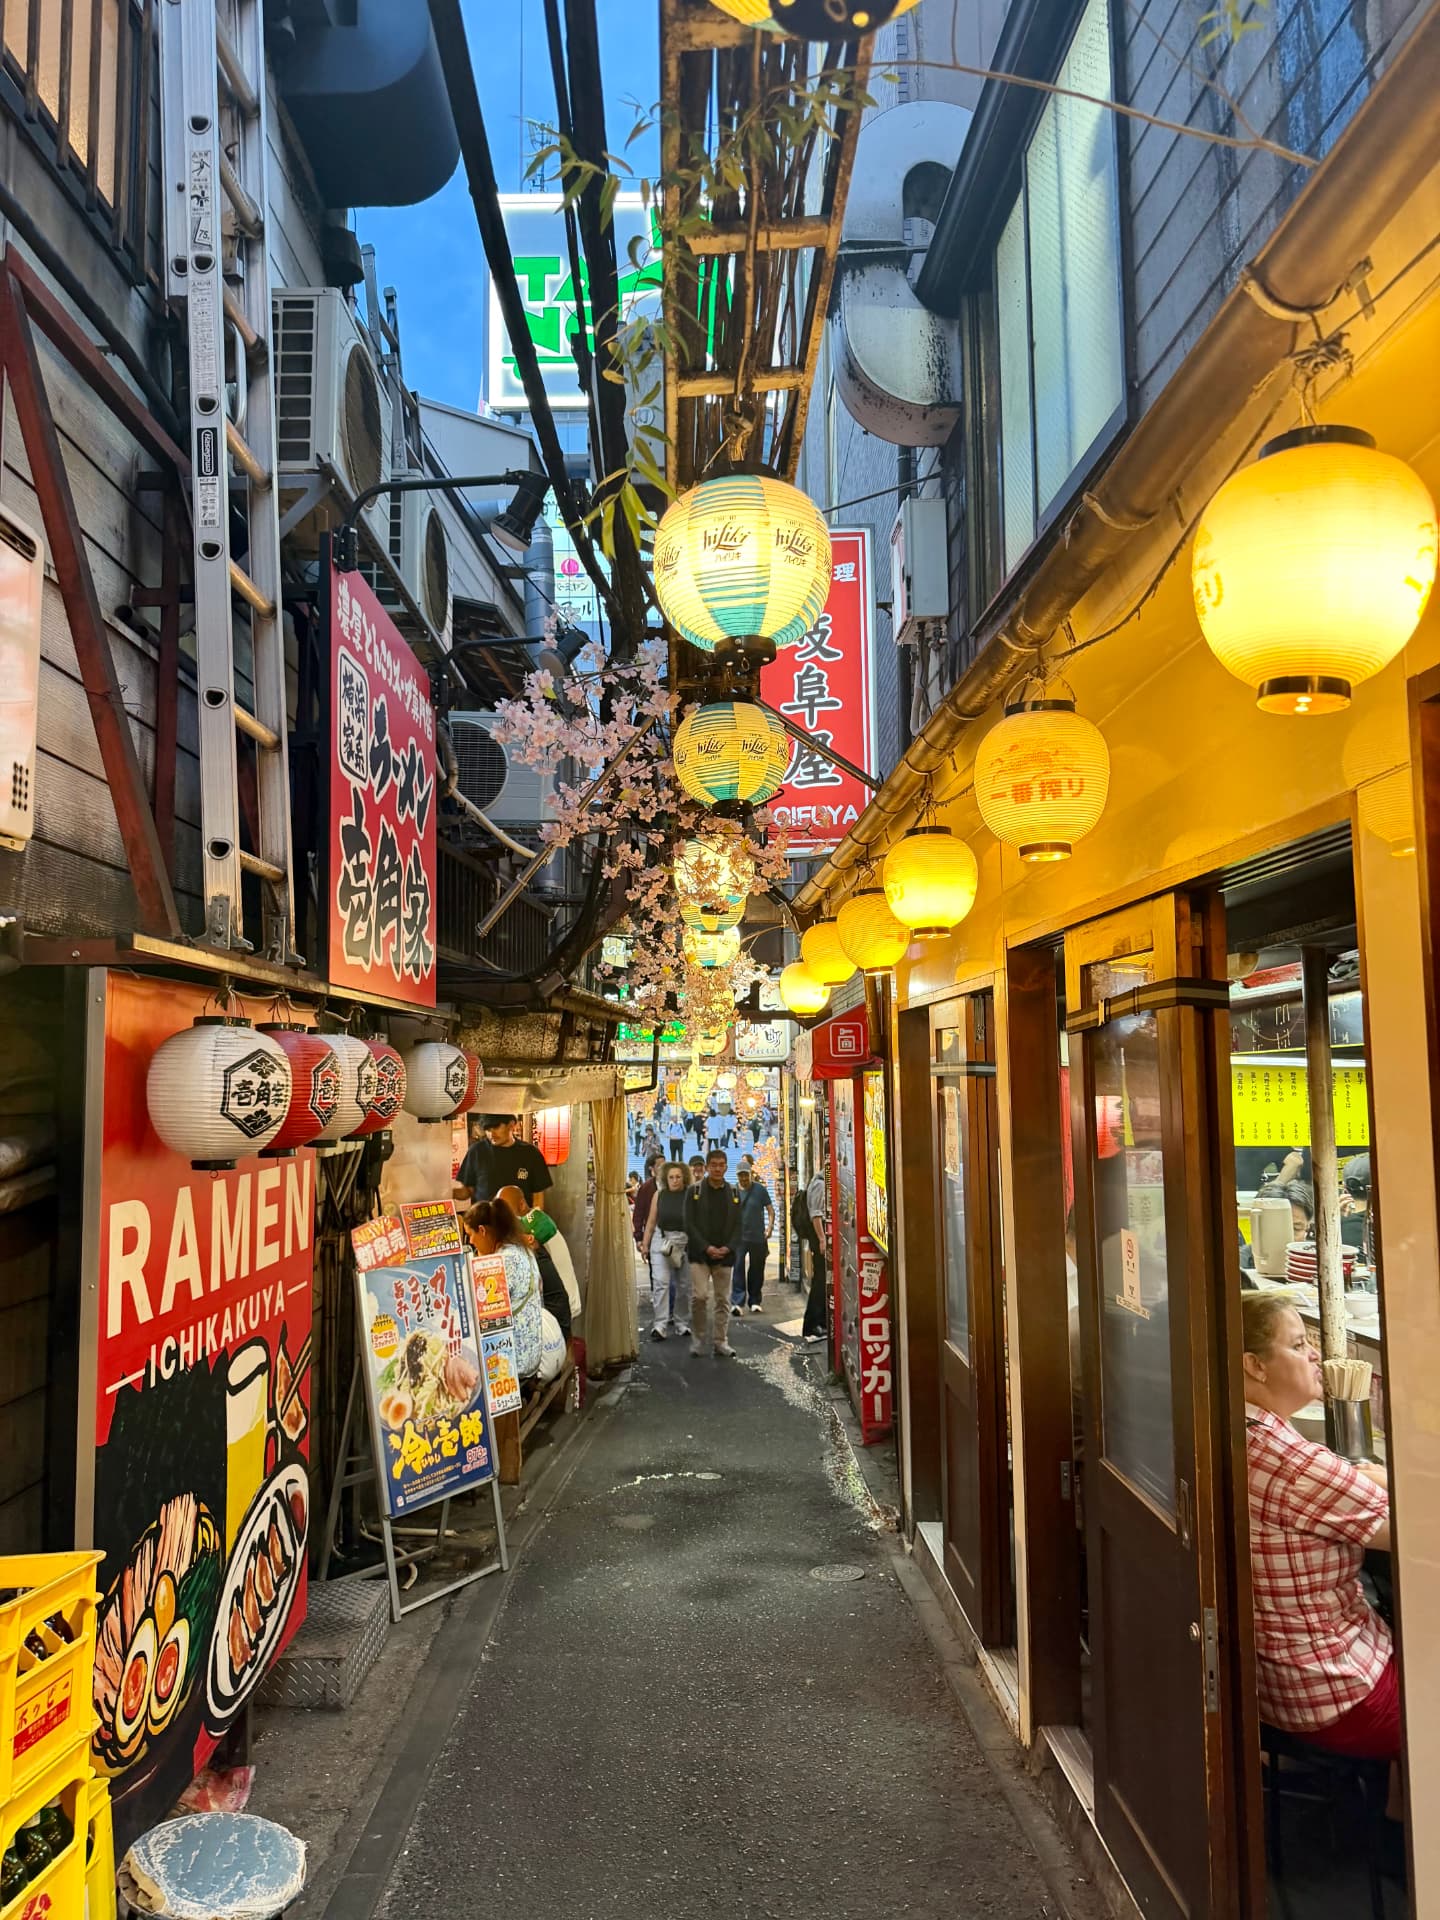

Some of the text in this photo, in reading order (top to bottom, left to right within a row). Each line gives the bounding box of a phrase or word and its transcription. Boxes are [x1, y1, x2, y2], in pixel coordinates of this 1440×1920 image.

[337, 577, 434, 743] 濃厚とんこつスープ専門店
[370, 695, 433, 838] ラーメン
[990, 777, 1085, 804] 一番搾り
[107, 1160, 311, 1340] RAMEN
[150, 1280, 286, 1389] ICHIKAKUYA
[17, 1681, 70, 1731] ホッピー
